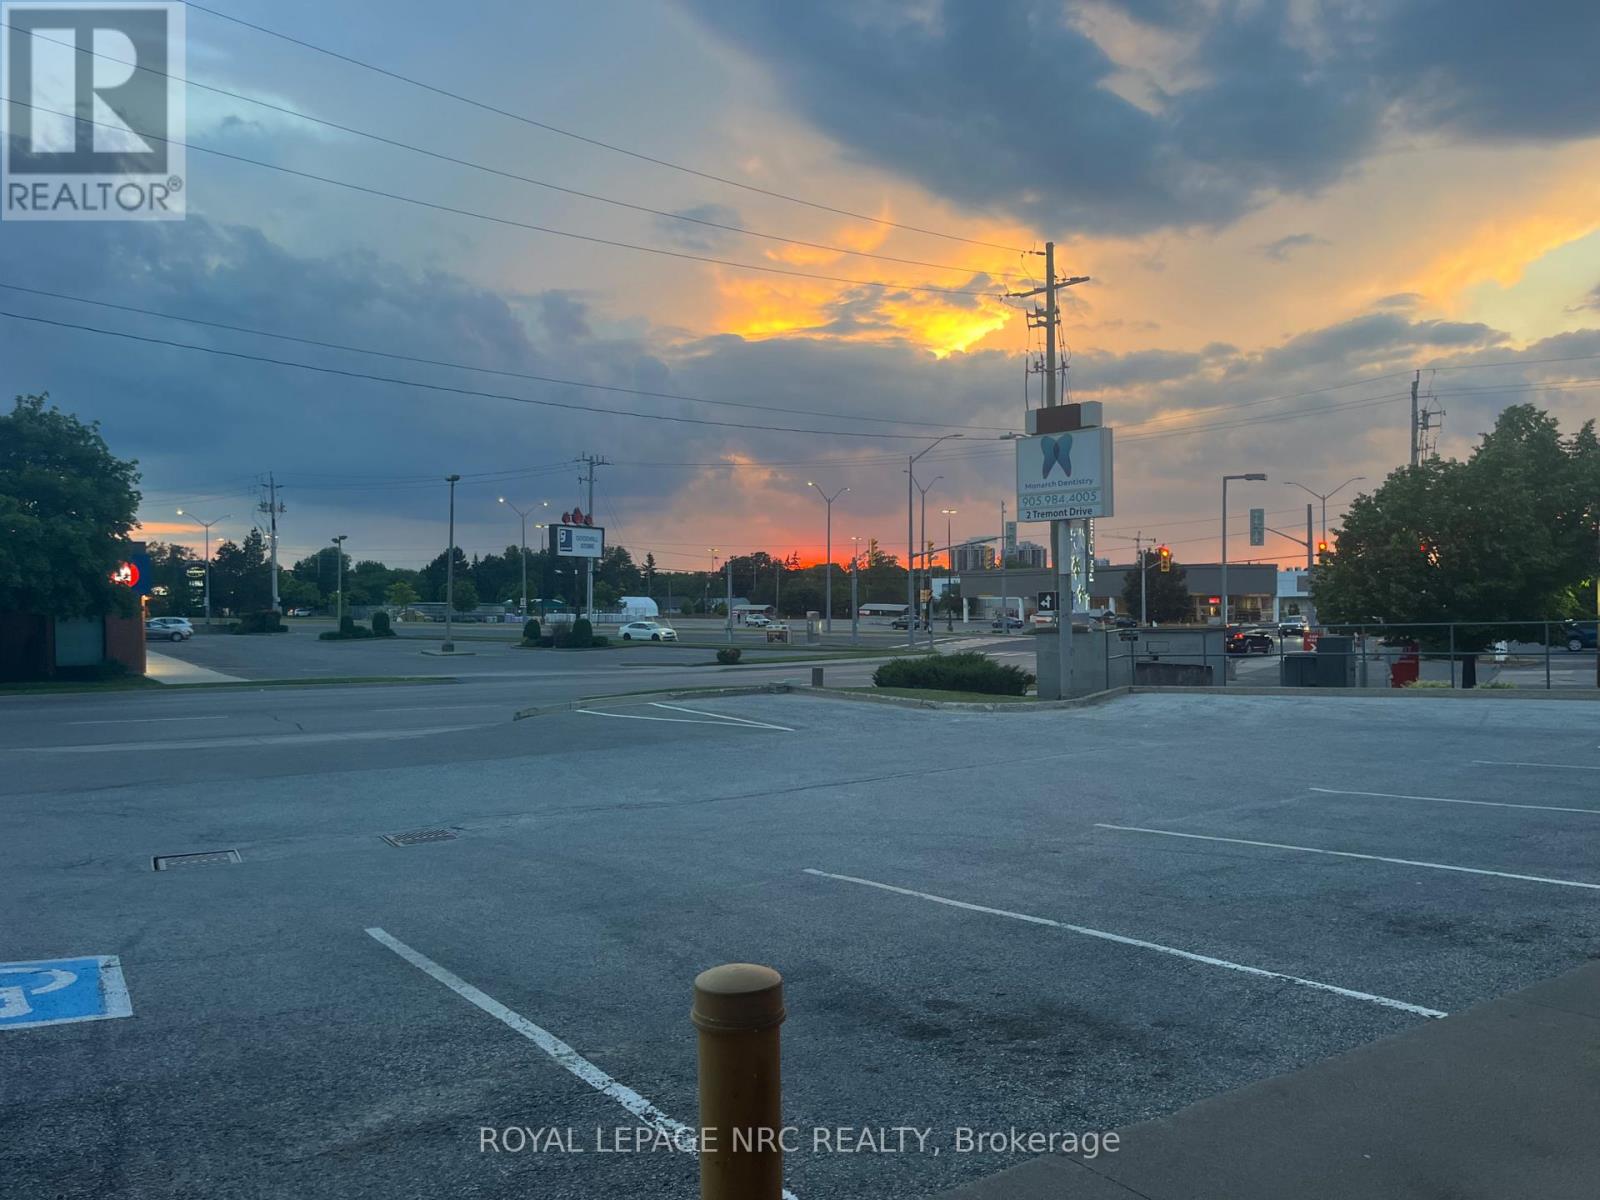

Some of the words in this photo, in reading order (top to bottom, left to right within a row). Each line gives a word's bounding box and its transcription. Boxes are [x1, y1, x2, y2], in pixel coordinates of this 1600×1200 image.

[1058, 478, 1093, 487] Dentistry
[1022, 496, 1042, 506] 905
[1026, 511, 1031, 519] 2
[1033, 509, 1068, 518] Tremont
[1069, 506, 1093, 516] Drive
